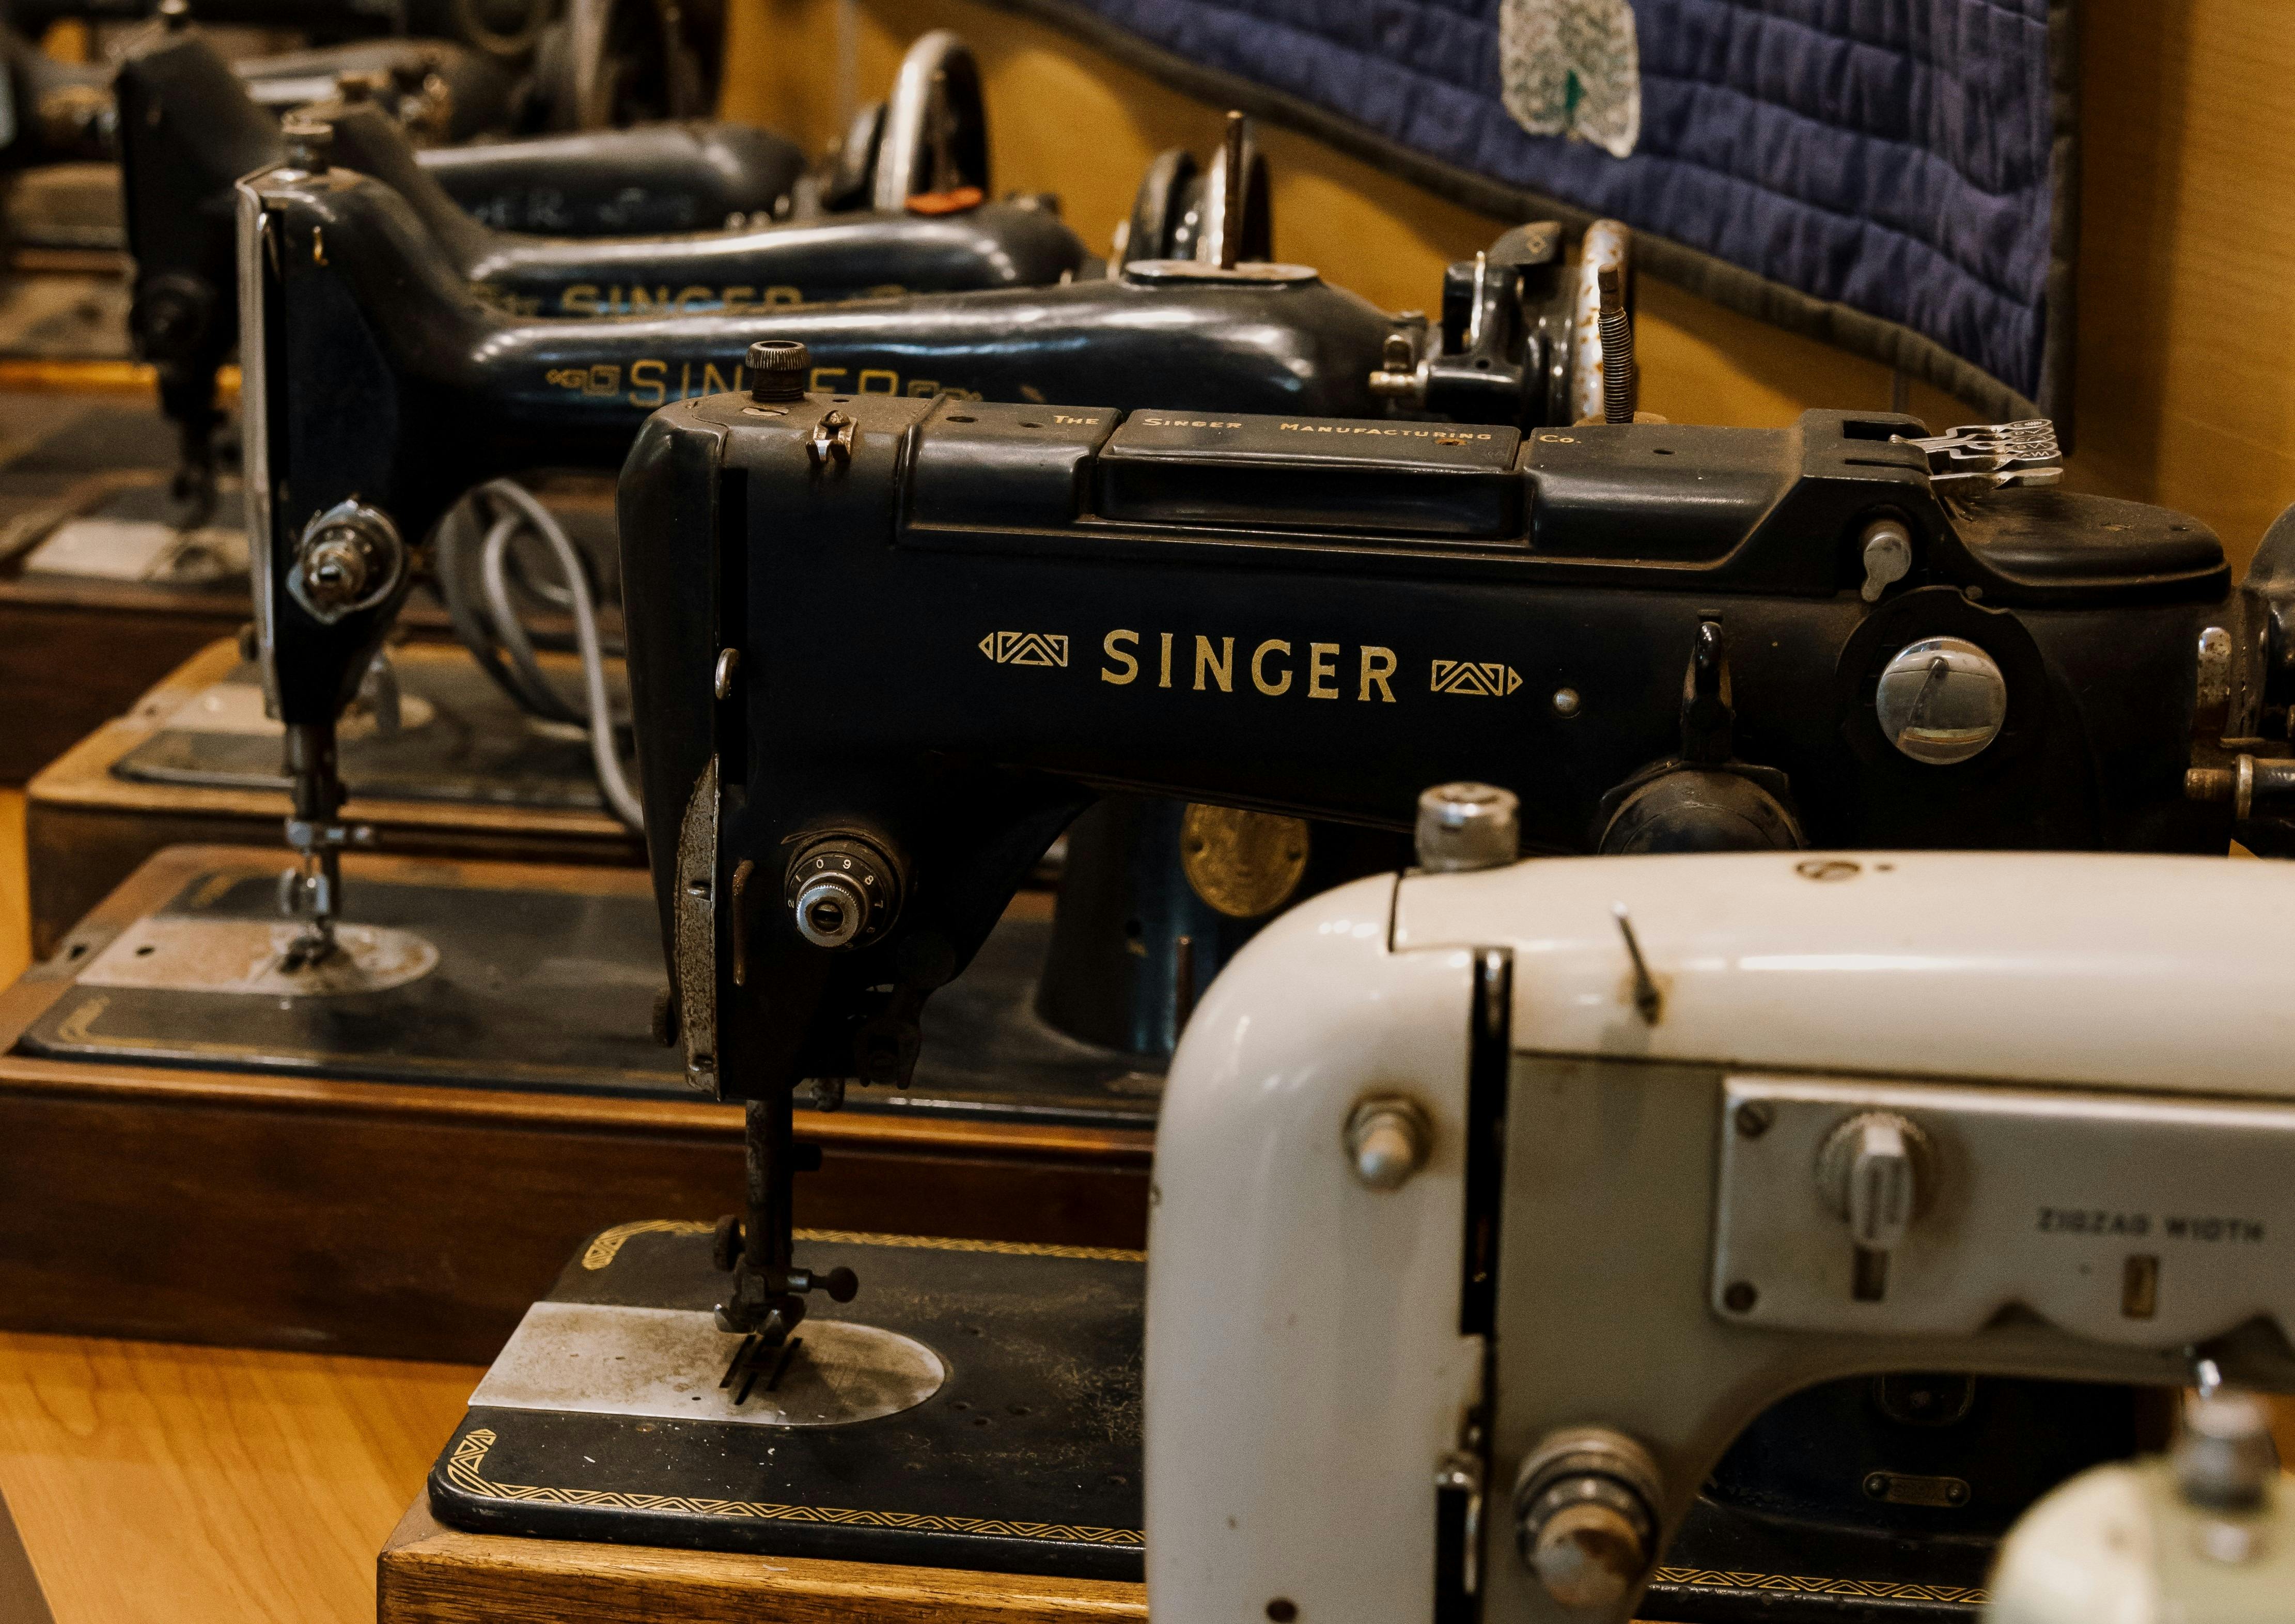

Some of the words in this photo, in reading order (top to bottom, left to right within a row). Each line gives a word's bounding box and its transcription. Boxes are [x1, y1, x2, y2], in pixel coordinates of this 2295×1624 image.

[1053, 415, 1100, 425] THE
[1142, 418, 1242, 429] SINGER
[1279, 423, 1492, 440] MANUFACTURING
[1101, 628, 1398, 704] SINGER
[816, 858, 824, 869] 0
[842, 858, 852, 869] 9
[864, 875, 875, 885] 8
[2166, 1217, 2265, 1242] WIDTH
